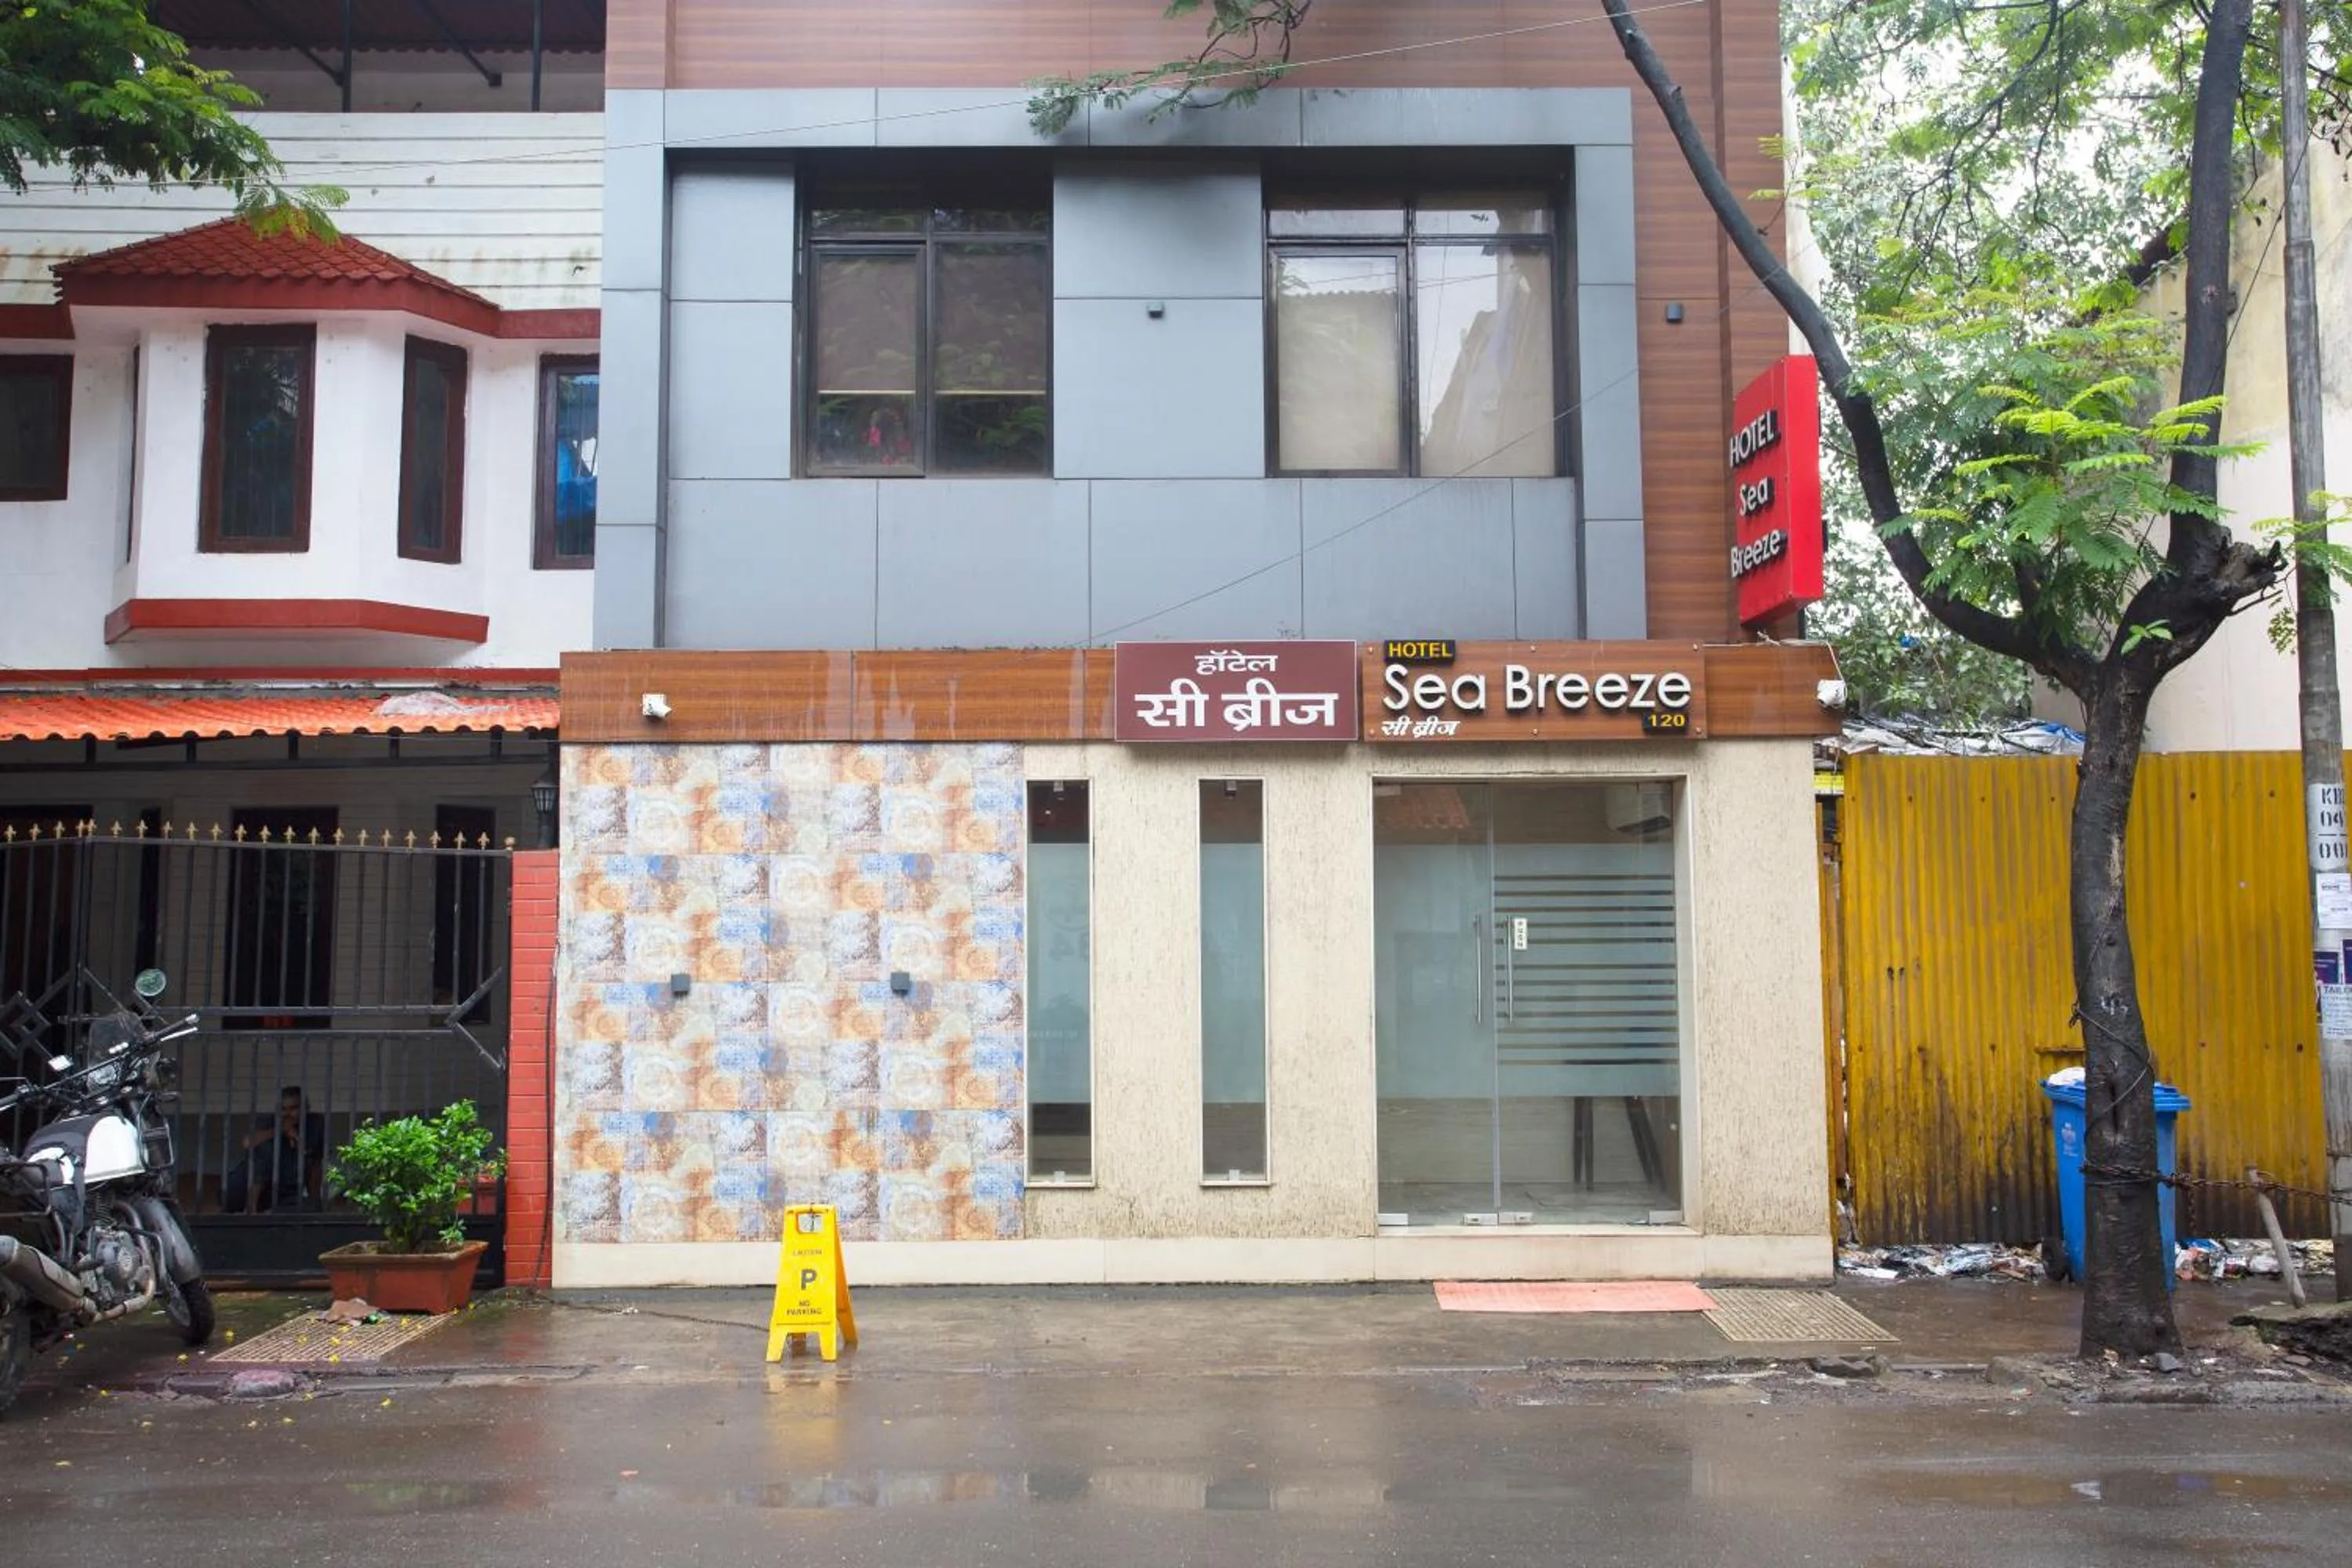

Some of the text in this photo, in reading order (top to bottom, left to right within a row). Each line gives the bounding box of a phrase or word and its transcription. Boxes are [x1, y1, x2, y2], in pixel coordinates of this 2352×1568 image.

[1730, 410, 1775, 468] HOTEL
[1739, 476, 1769, 516] Sea
[1730, 528, 1780, 579] Breeze
[1194, 650, 1279, 675] हॉटेल
[1388, 642, 1453, 658] HOTEL
[1383, 663, 1692, 710] Sea Breeze
[1134, 677, 1340, 731] सी ब्रीज
[1381, 714, 1461, 738] सी ब्रीज
[1648, 714, 1686, 728] 120
[801, 1269, 817, 1290] P
